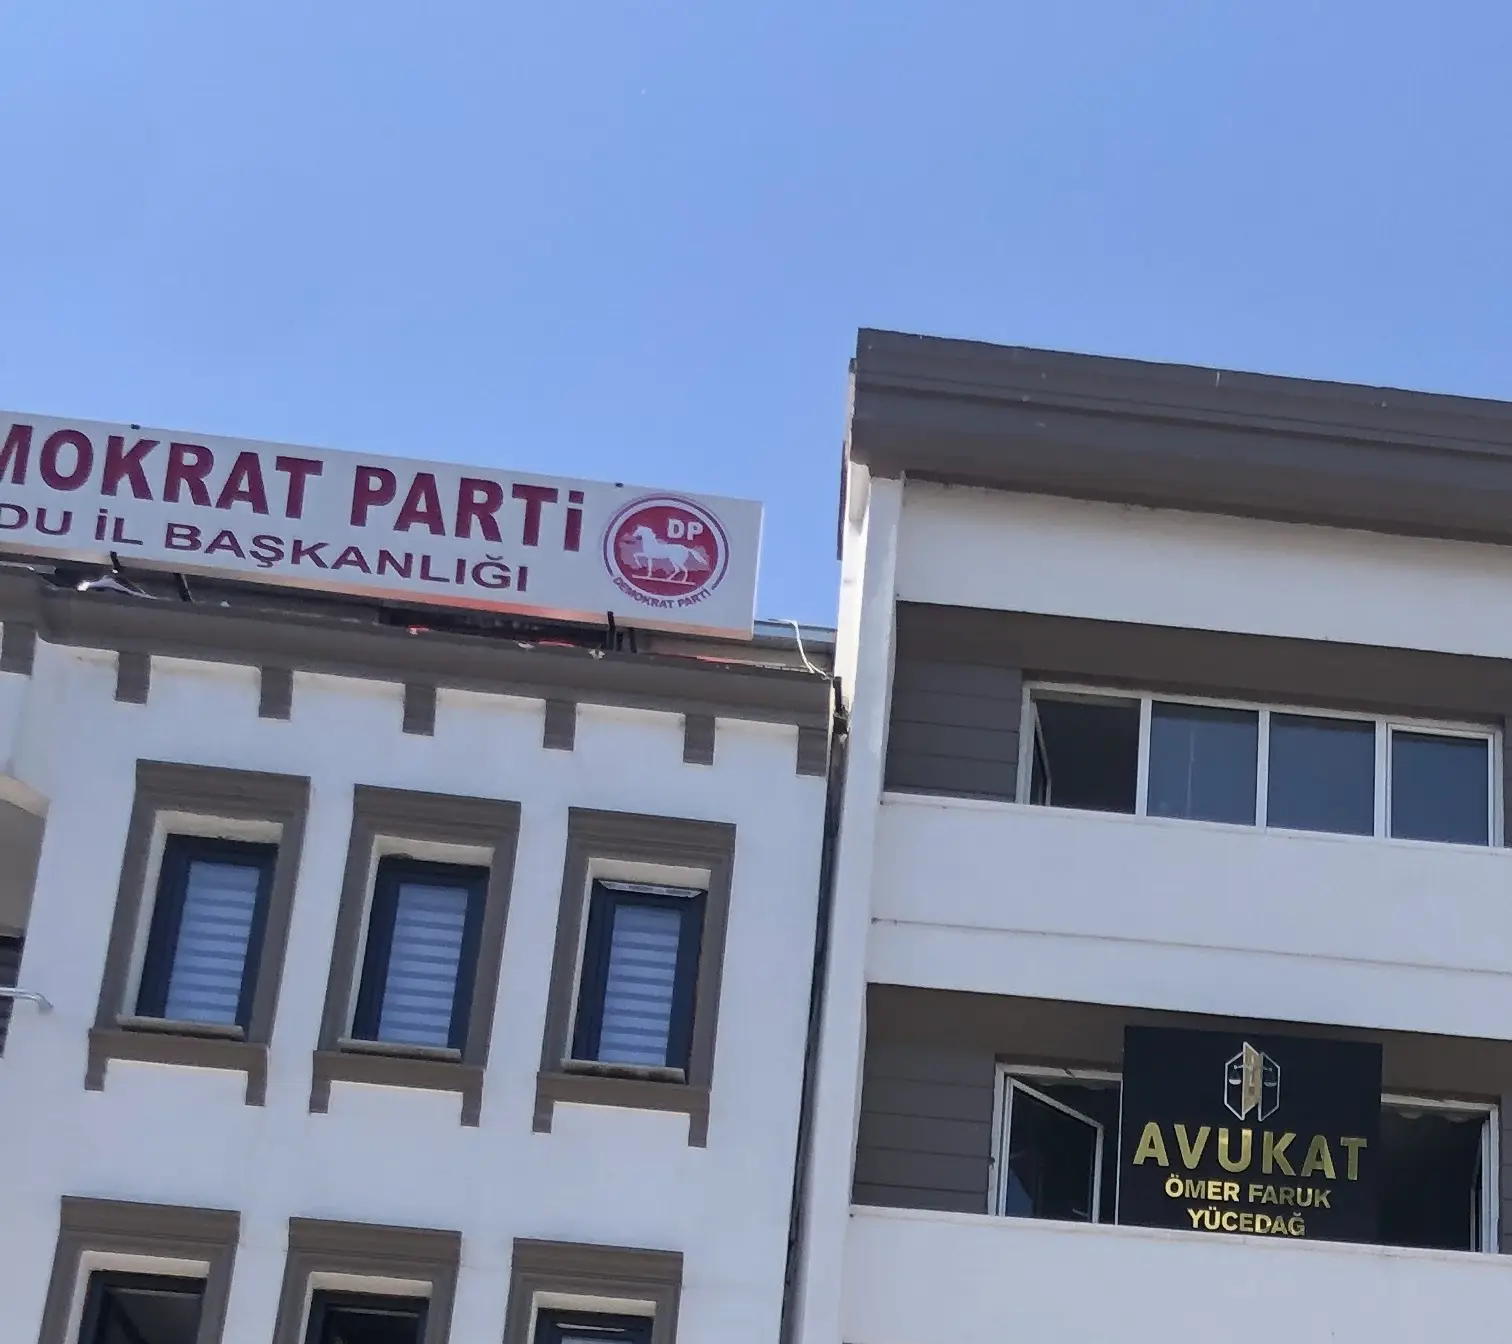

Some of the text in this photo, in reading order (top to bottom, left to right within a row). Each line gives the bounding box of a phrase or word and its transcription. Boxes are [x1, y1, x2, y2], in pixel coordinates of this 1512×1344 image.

[667, 518, 704, 541] DP
[95, 508, 143, 545] İL
[165, 522, 530, 593] BAŞKANLIĞI
[613, 577, 674, 608] DEMOKRAT
[1133, 1121, 1368, 1181] AVUKAT
[1165, 1173, 1331, 1208] ÖMER FARUK
[1187, 1206, 1306, 1237] YÜCEDAĞ
